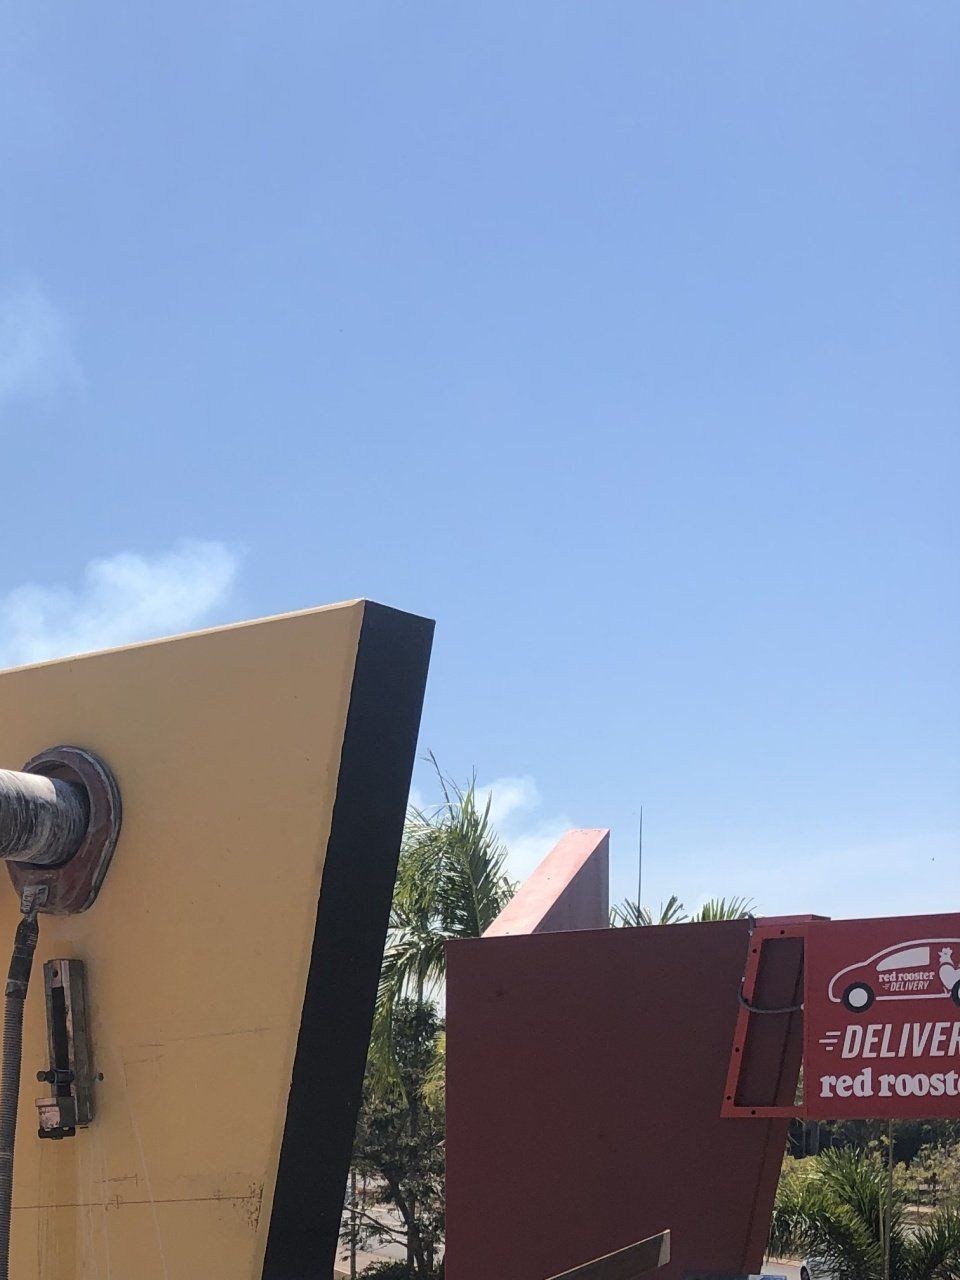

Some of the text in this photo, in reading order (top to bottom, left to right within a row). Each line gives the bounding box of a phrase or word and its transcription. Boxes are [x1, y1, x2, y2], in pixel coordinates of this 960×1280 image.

[878, 971, 935, 982] red rooster
[890, 981, 929, 991] DELIVERY
[820, 1067, 960, 1097] red roost
